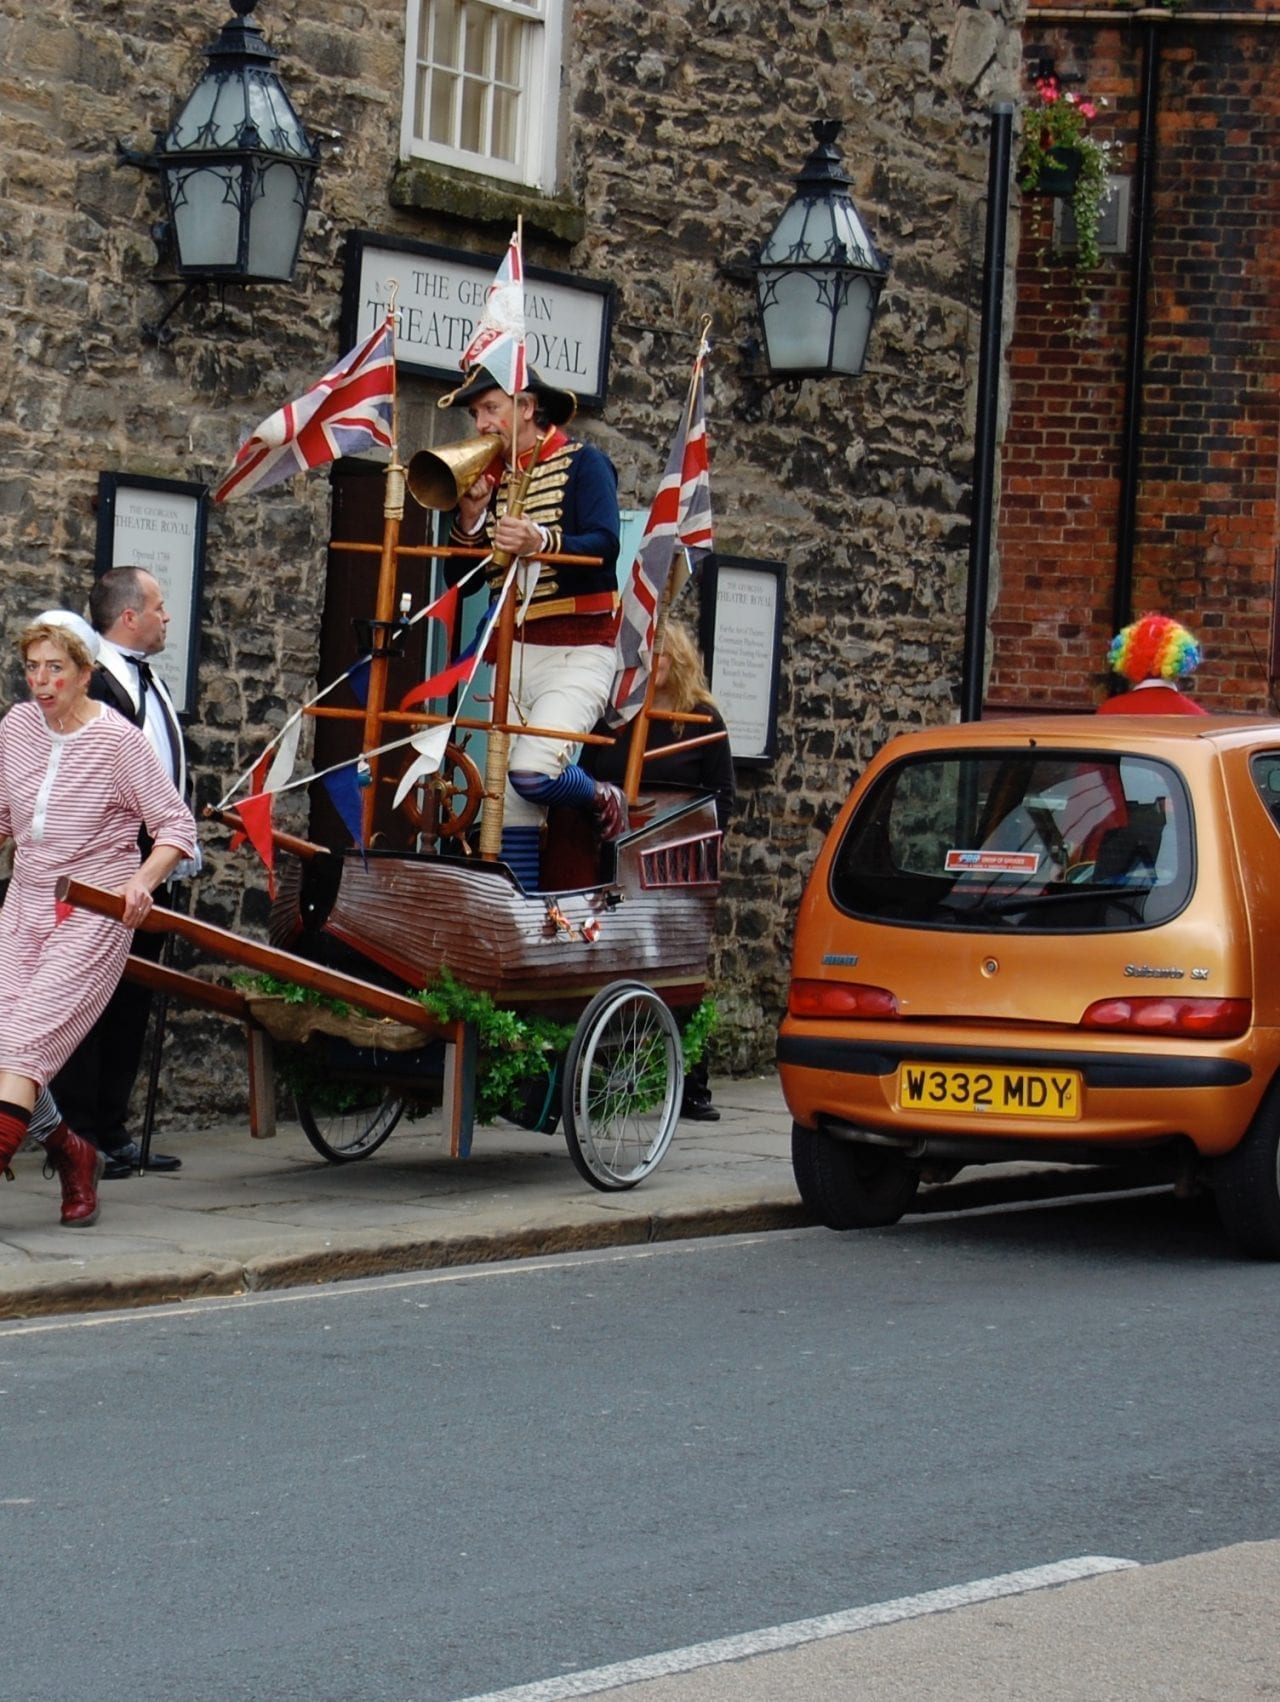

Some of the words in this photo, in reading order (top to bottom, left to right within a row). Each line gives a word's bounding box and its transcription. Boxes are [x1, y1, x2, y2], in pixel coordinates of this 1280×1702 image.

[412, 270, 450, 300] THE
[458, 280, 553, 321] GEIAN
[366, 299, 476, 352] THEATR
[525, 330, 587, 376] OYAL
[114, 515, 158, 531] THEATRE
[160, 521, 192, 536] ROYAL
[906, 1069, 993, 1105] W332
[1004, 1075, 1072, 1109] MDY
